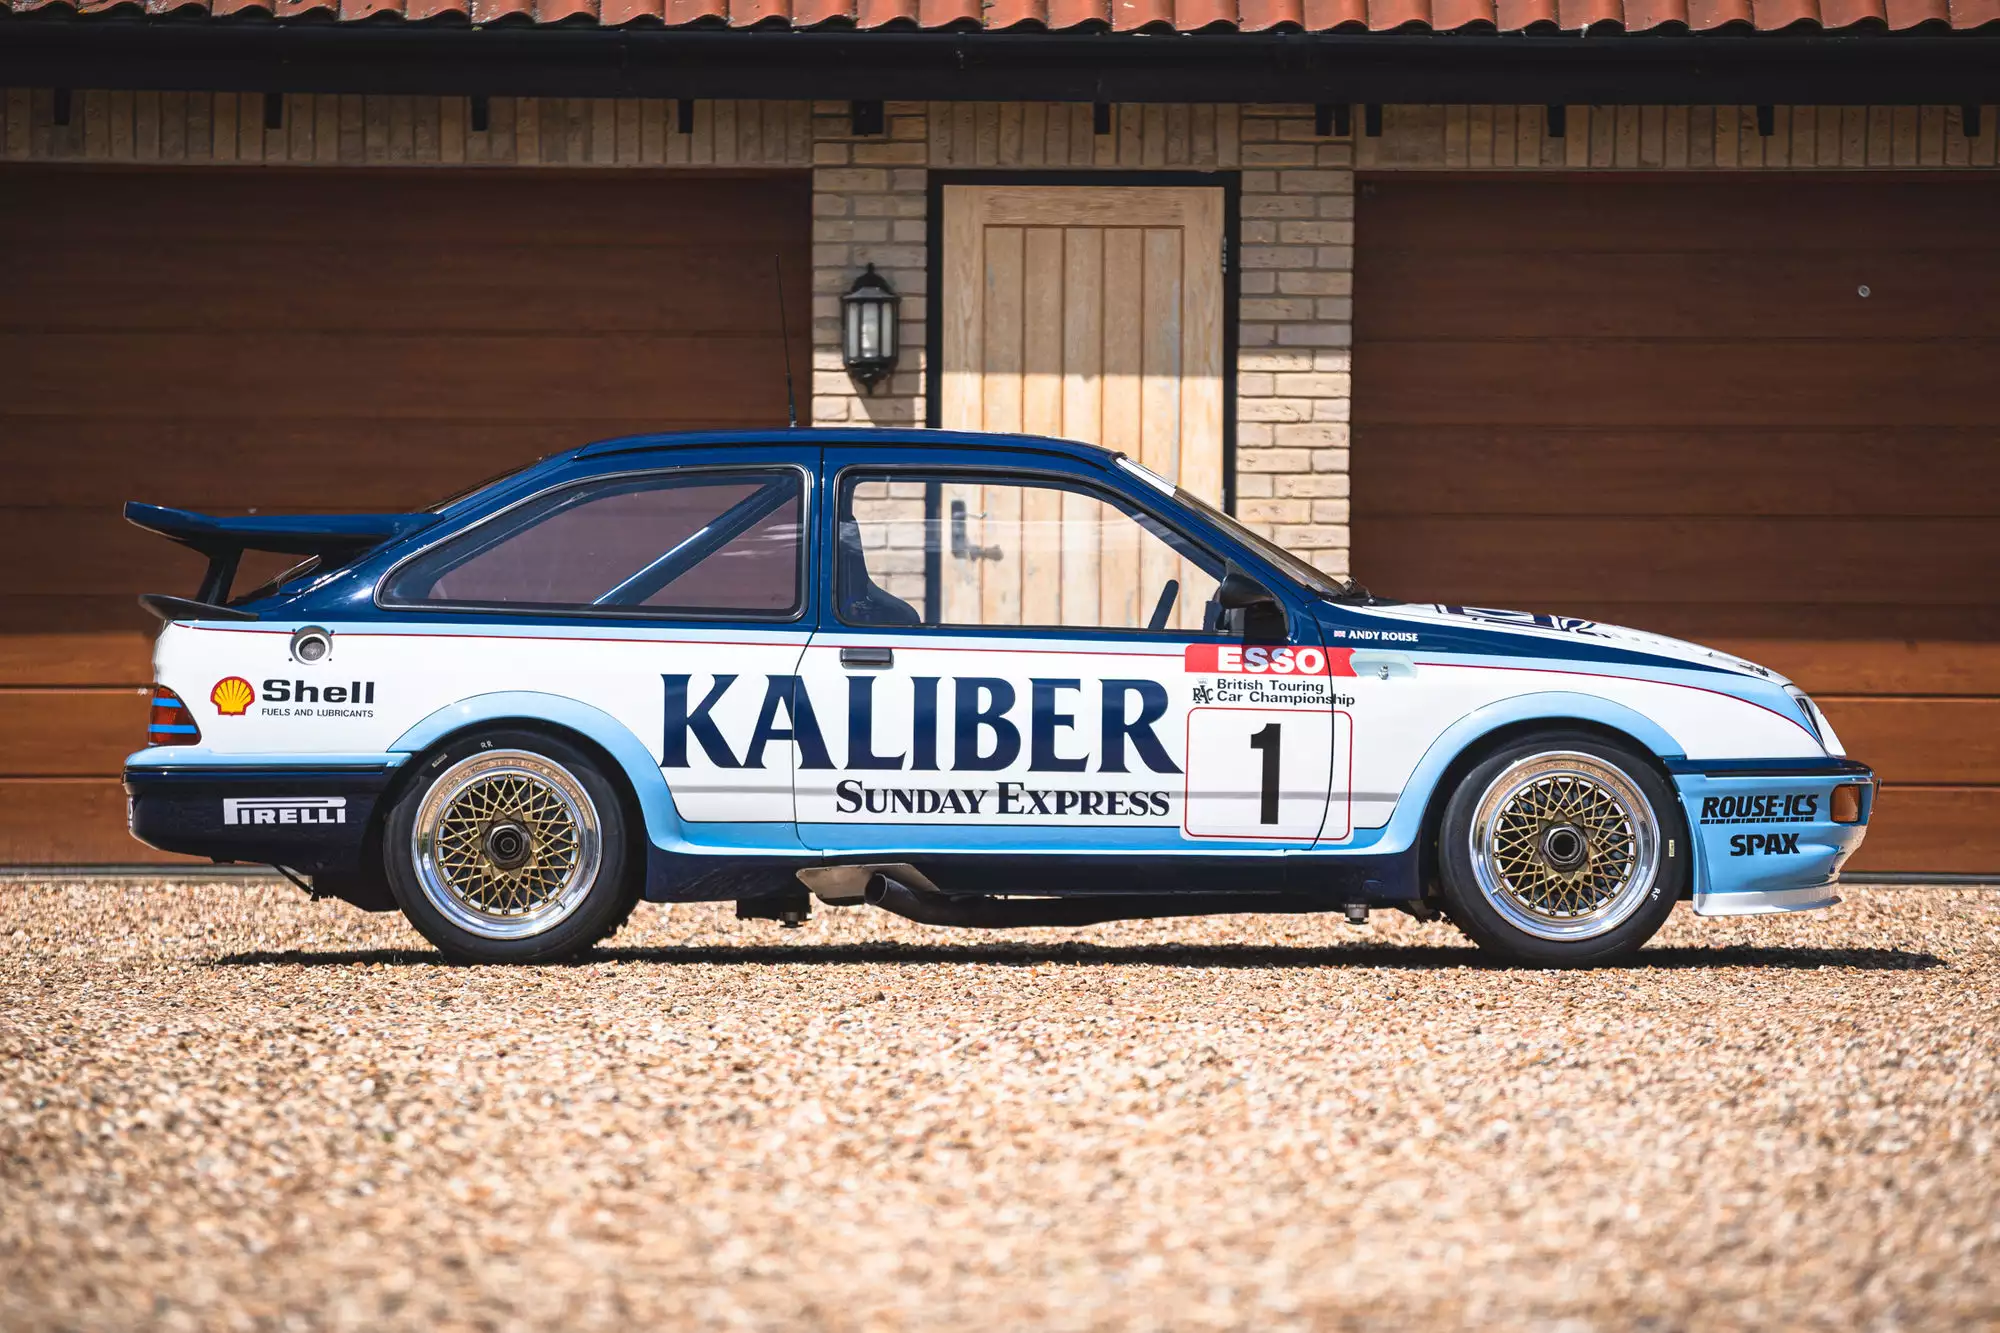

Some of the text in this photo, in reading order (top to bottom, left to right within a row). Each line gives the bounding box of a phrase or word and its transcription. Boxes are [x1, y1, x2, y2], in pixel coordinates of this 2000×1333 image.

[1348, 630, 1419, 642] ANDY ROUSE
[1217, 646, 1325, 675] ESSO
[262, 679, 375, 704] Shell
[1216, 690, 1355, 707] Car Championship
[1217, 678, 1324, 694] British Touring
[261, 708, 374, 718] FUELS AND LUBRICANTS
[660, 673, 1185, 774] KALIBER
[1250, 723, 1281, 825] 1
[223, 796, 347, 825] PIRELLI
[836, 779, 1171, 817] SUNDAY EXPRESS
[1730, 833, 1800, 856] SPAX
